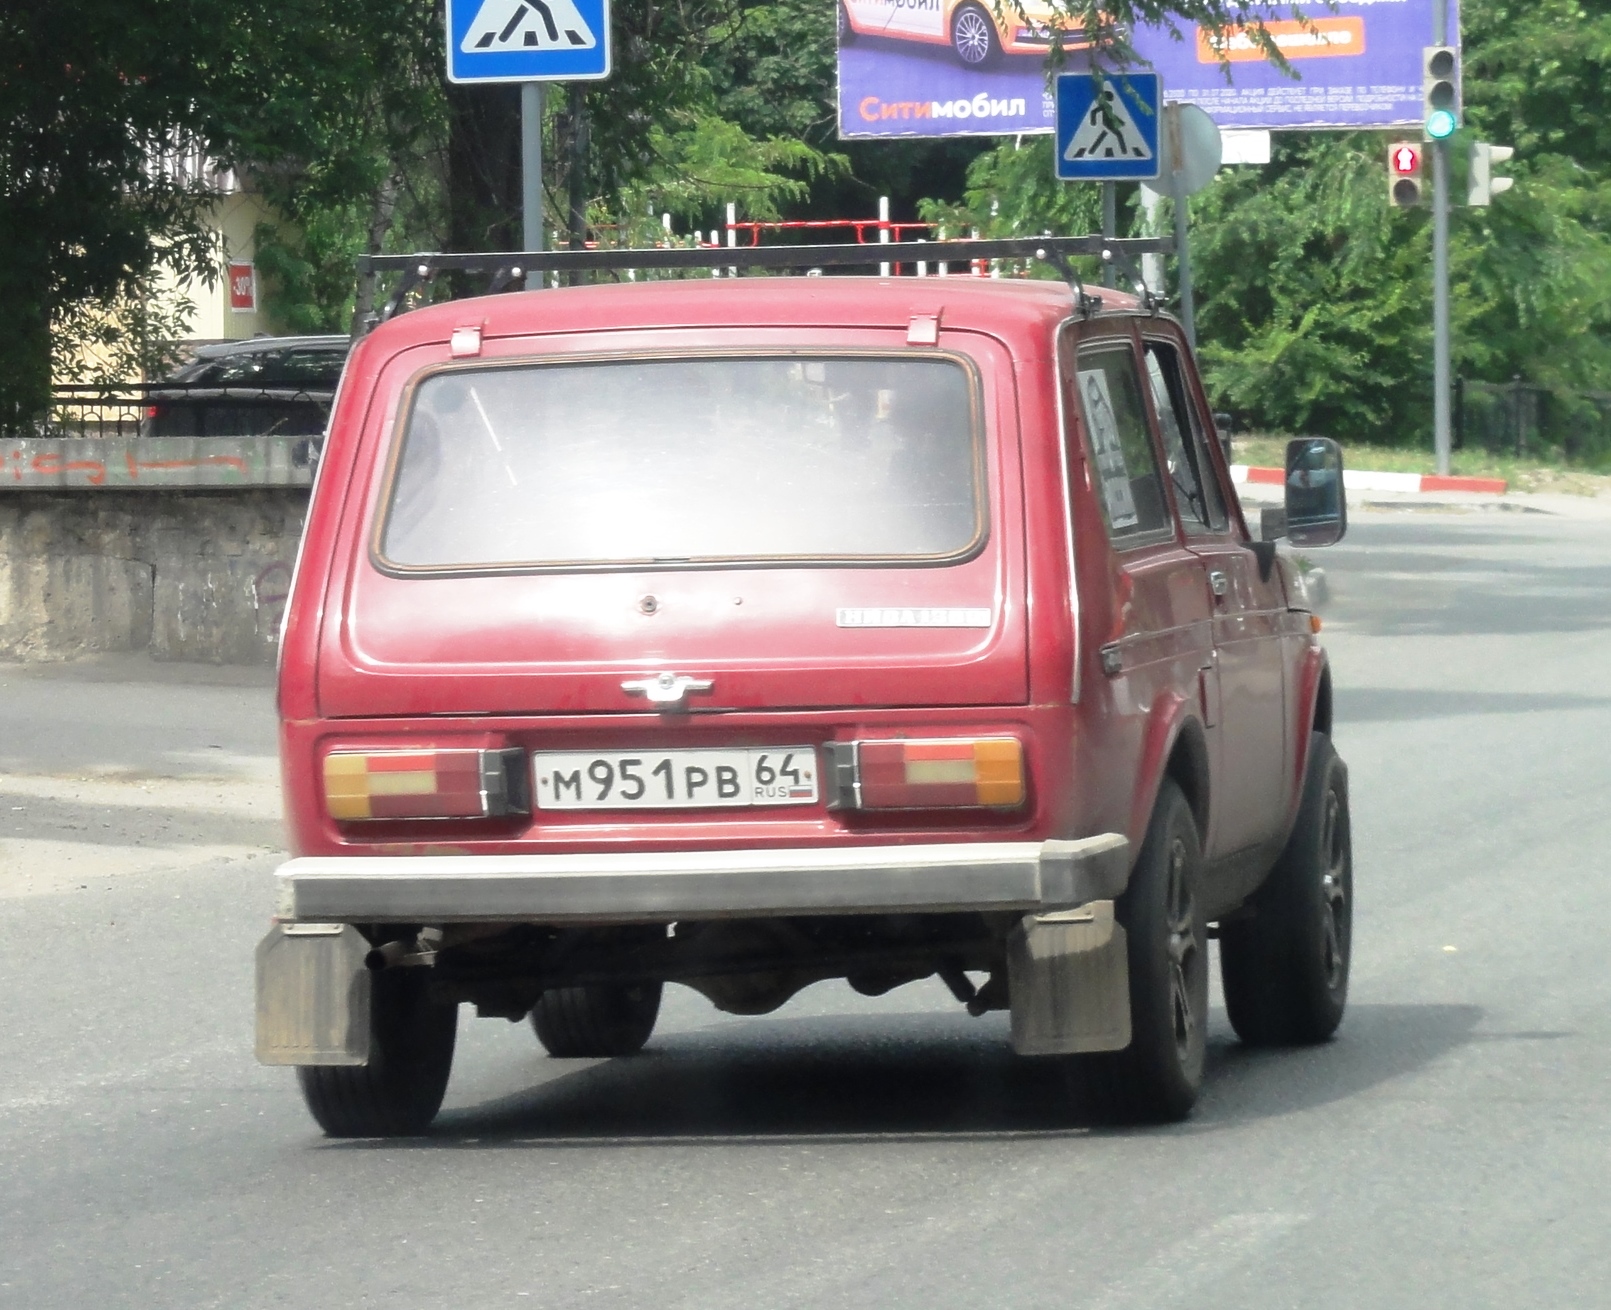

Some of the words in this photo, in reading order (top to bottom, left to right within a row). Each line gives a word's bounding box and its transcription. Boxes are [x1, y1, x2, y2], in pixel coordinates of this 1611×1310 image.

[859, 92, 1026, 122] Ситимобил
[755, 753, 800, 785] 64
[755, 785, 788, 798] RUS
